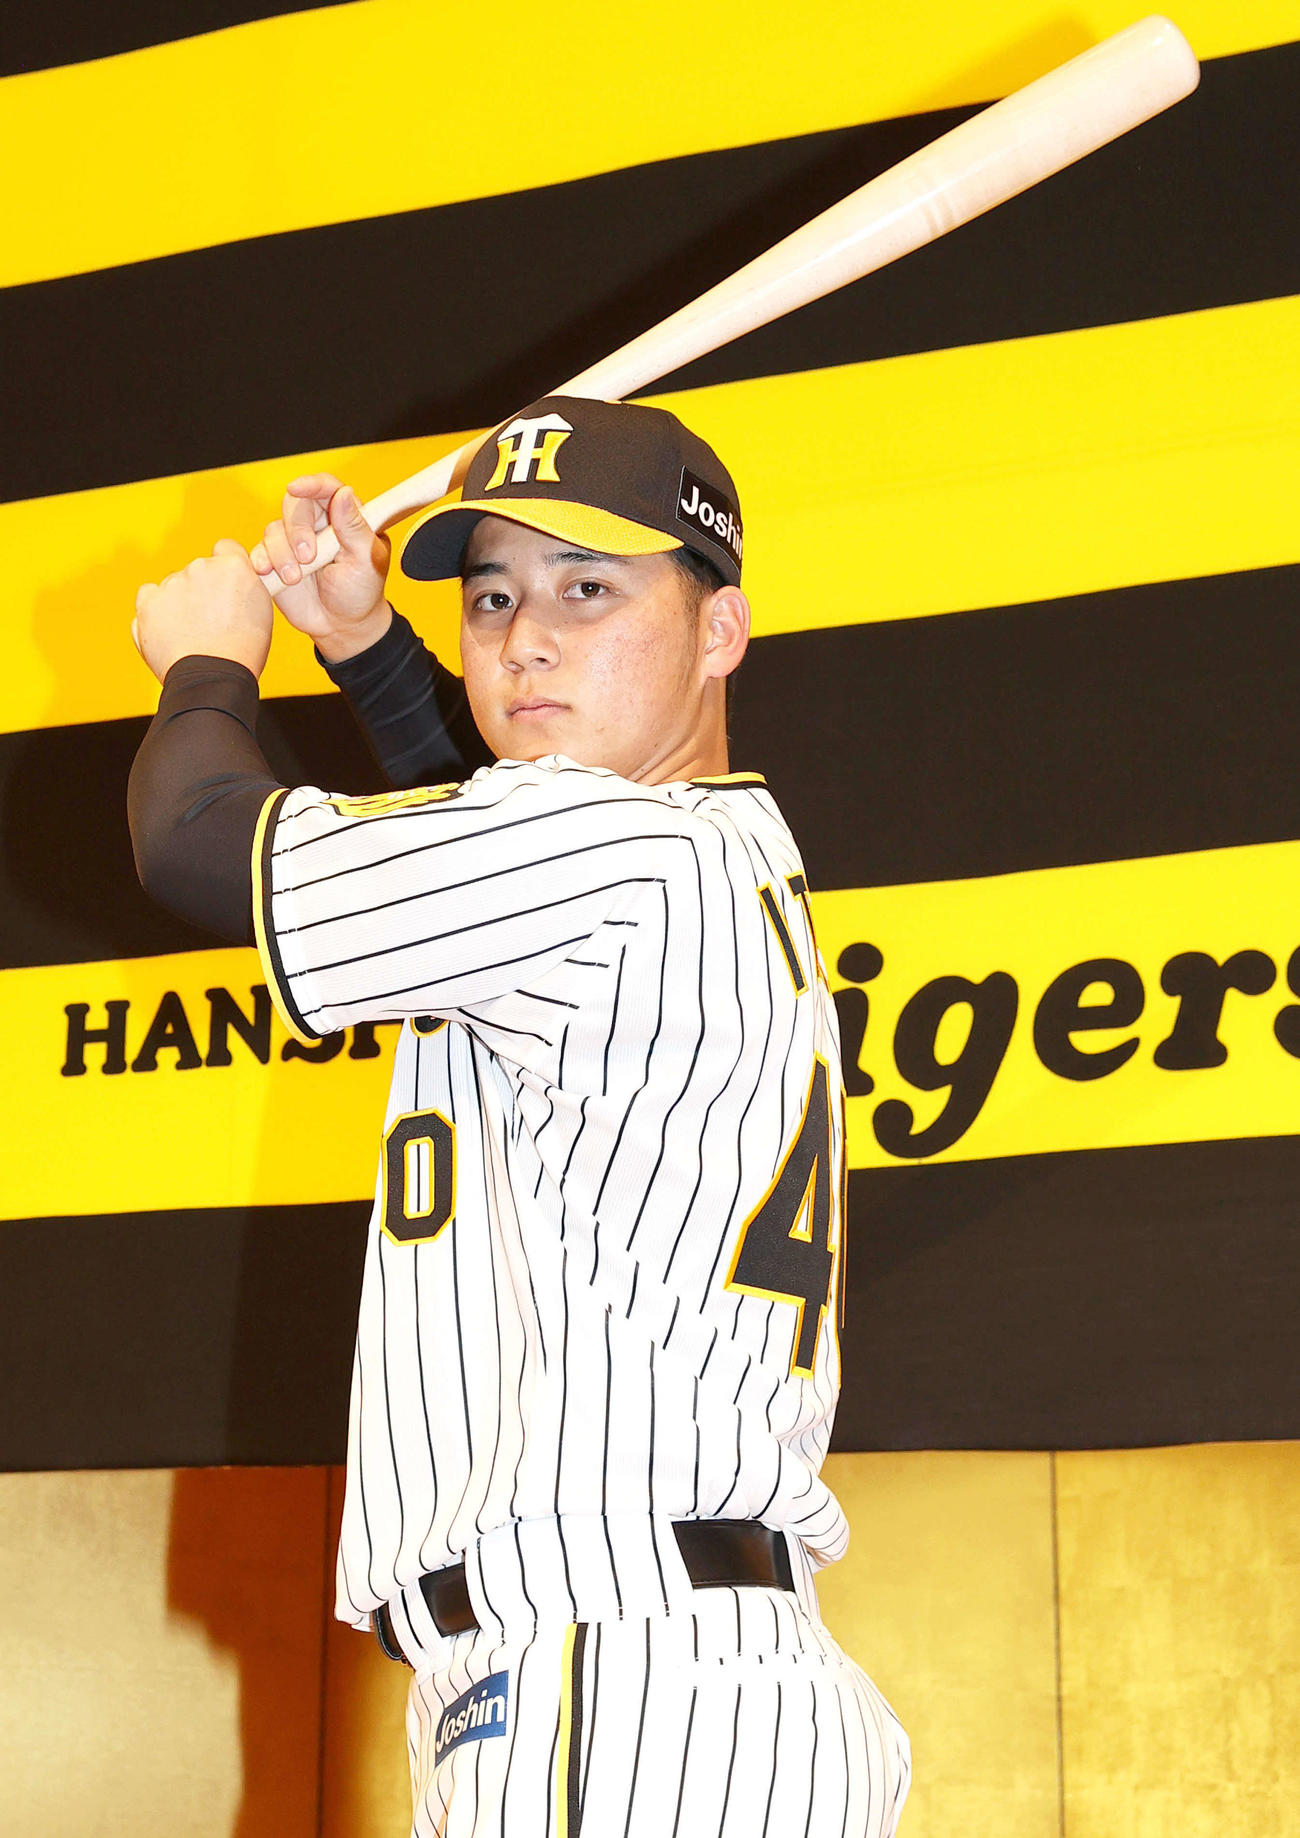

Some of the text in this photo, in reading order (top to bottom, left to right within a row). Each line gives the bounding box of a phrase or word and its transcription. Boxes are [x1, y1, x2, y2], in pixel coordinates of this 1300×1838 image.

[831, 942, 1300, 1160] iger
[723, 1051, 849, 1381] 4
[436, 1688, 506, 1754] Joshin
